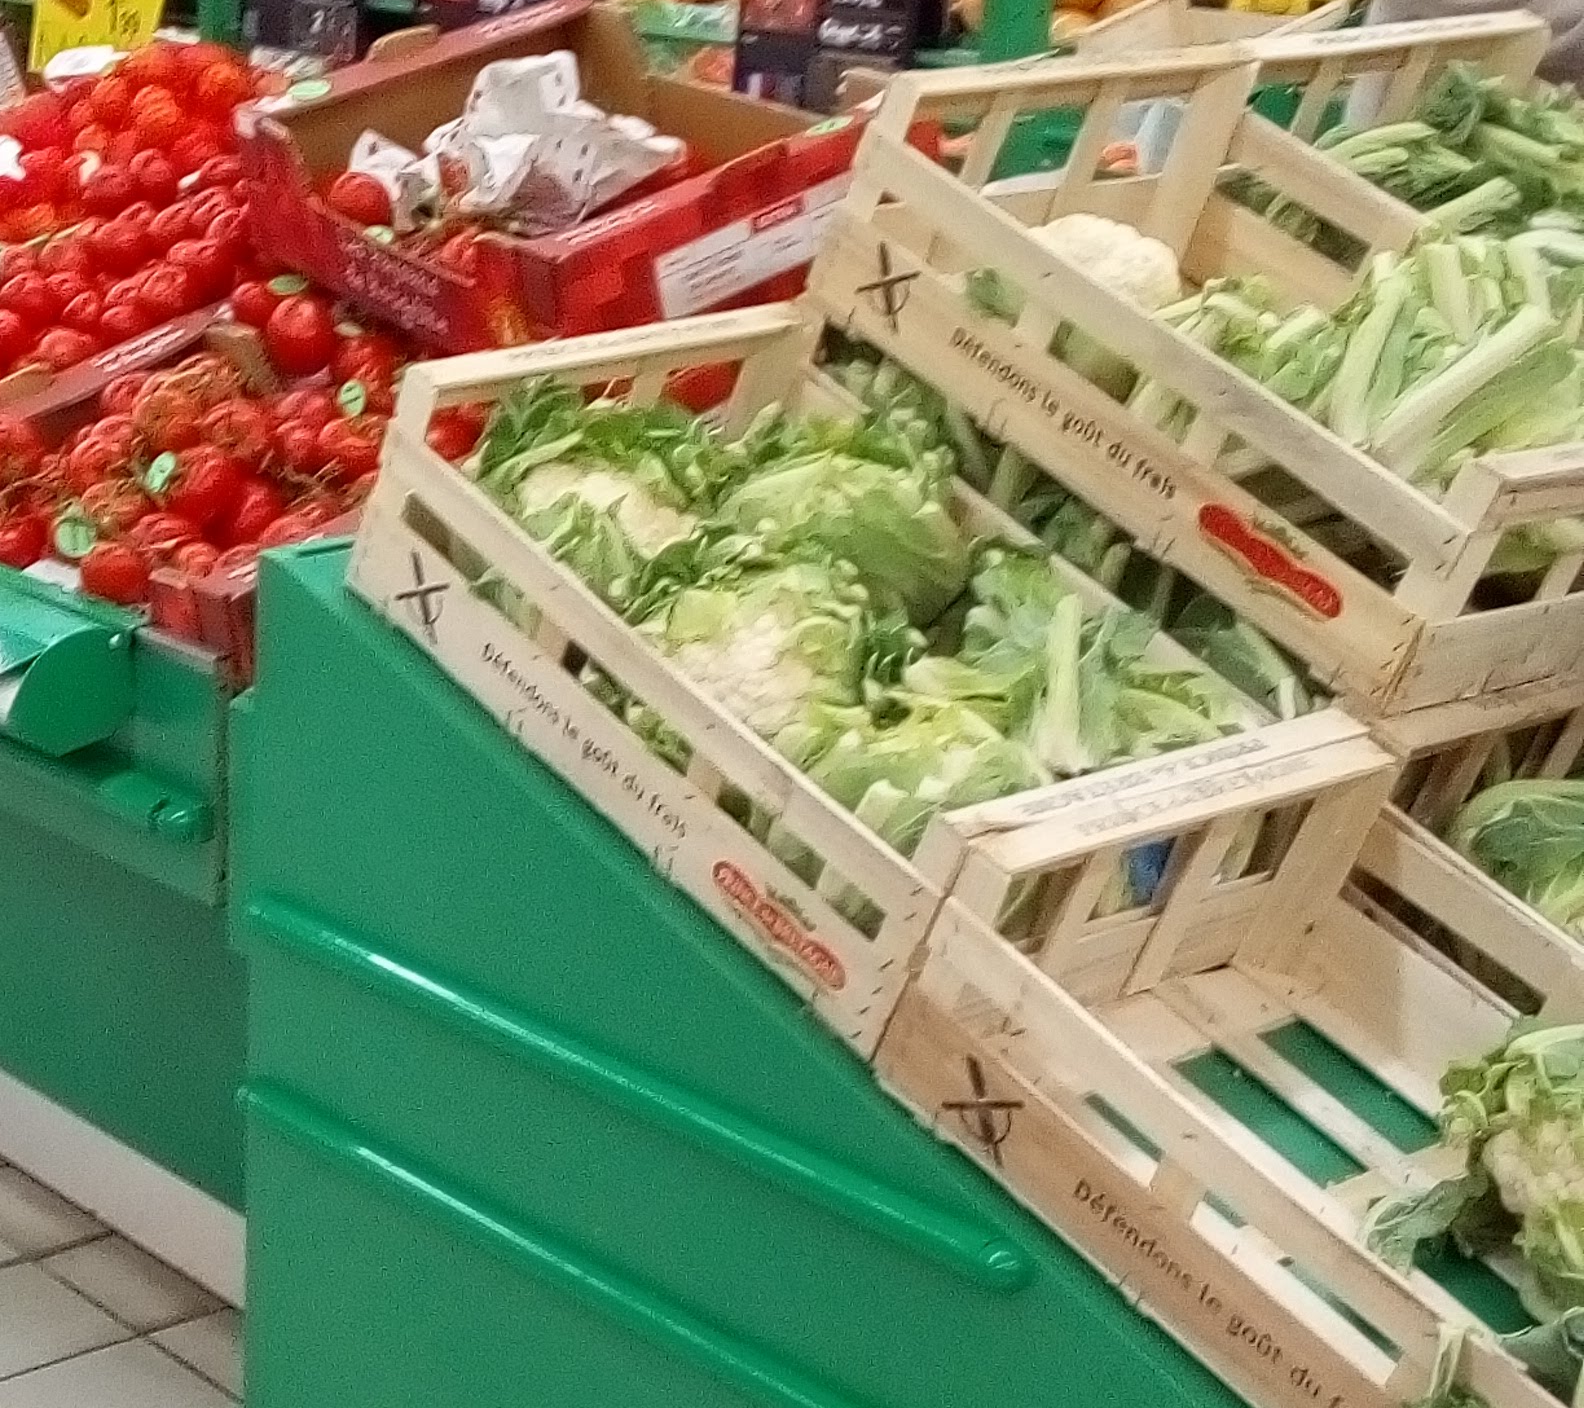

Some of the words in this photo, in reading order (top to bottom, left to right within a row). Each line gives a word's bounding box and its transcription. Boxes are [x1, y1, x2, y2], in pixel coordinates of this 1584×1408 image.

[949, 326, 1036, 403] Défendons
[1041, 389, 1060, 417] le
[1062, 409, 1104, 448] goût
[1107, 442, 1132, 467] du
[1132, 458, 1176, 499] frais
[562, 716, 580, 740] le
[622, 774, 645, 801] du
[648, 793, 686, 839] frais
[1073, 1178, 1192, 1290] Défendons
[1198, 1283, 1222, 1313] le
[1225, 1313, 1283, 1363] goût
[1290, 1364, 1321, 1398] du
